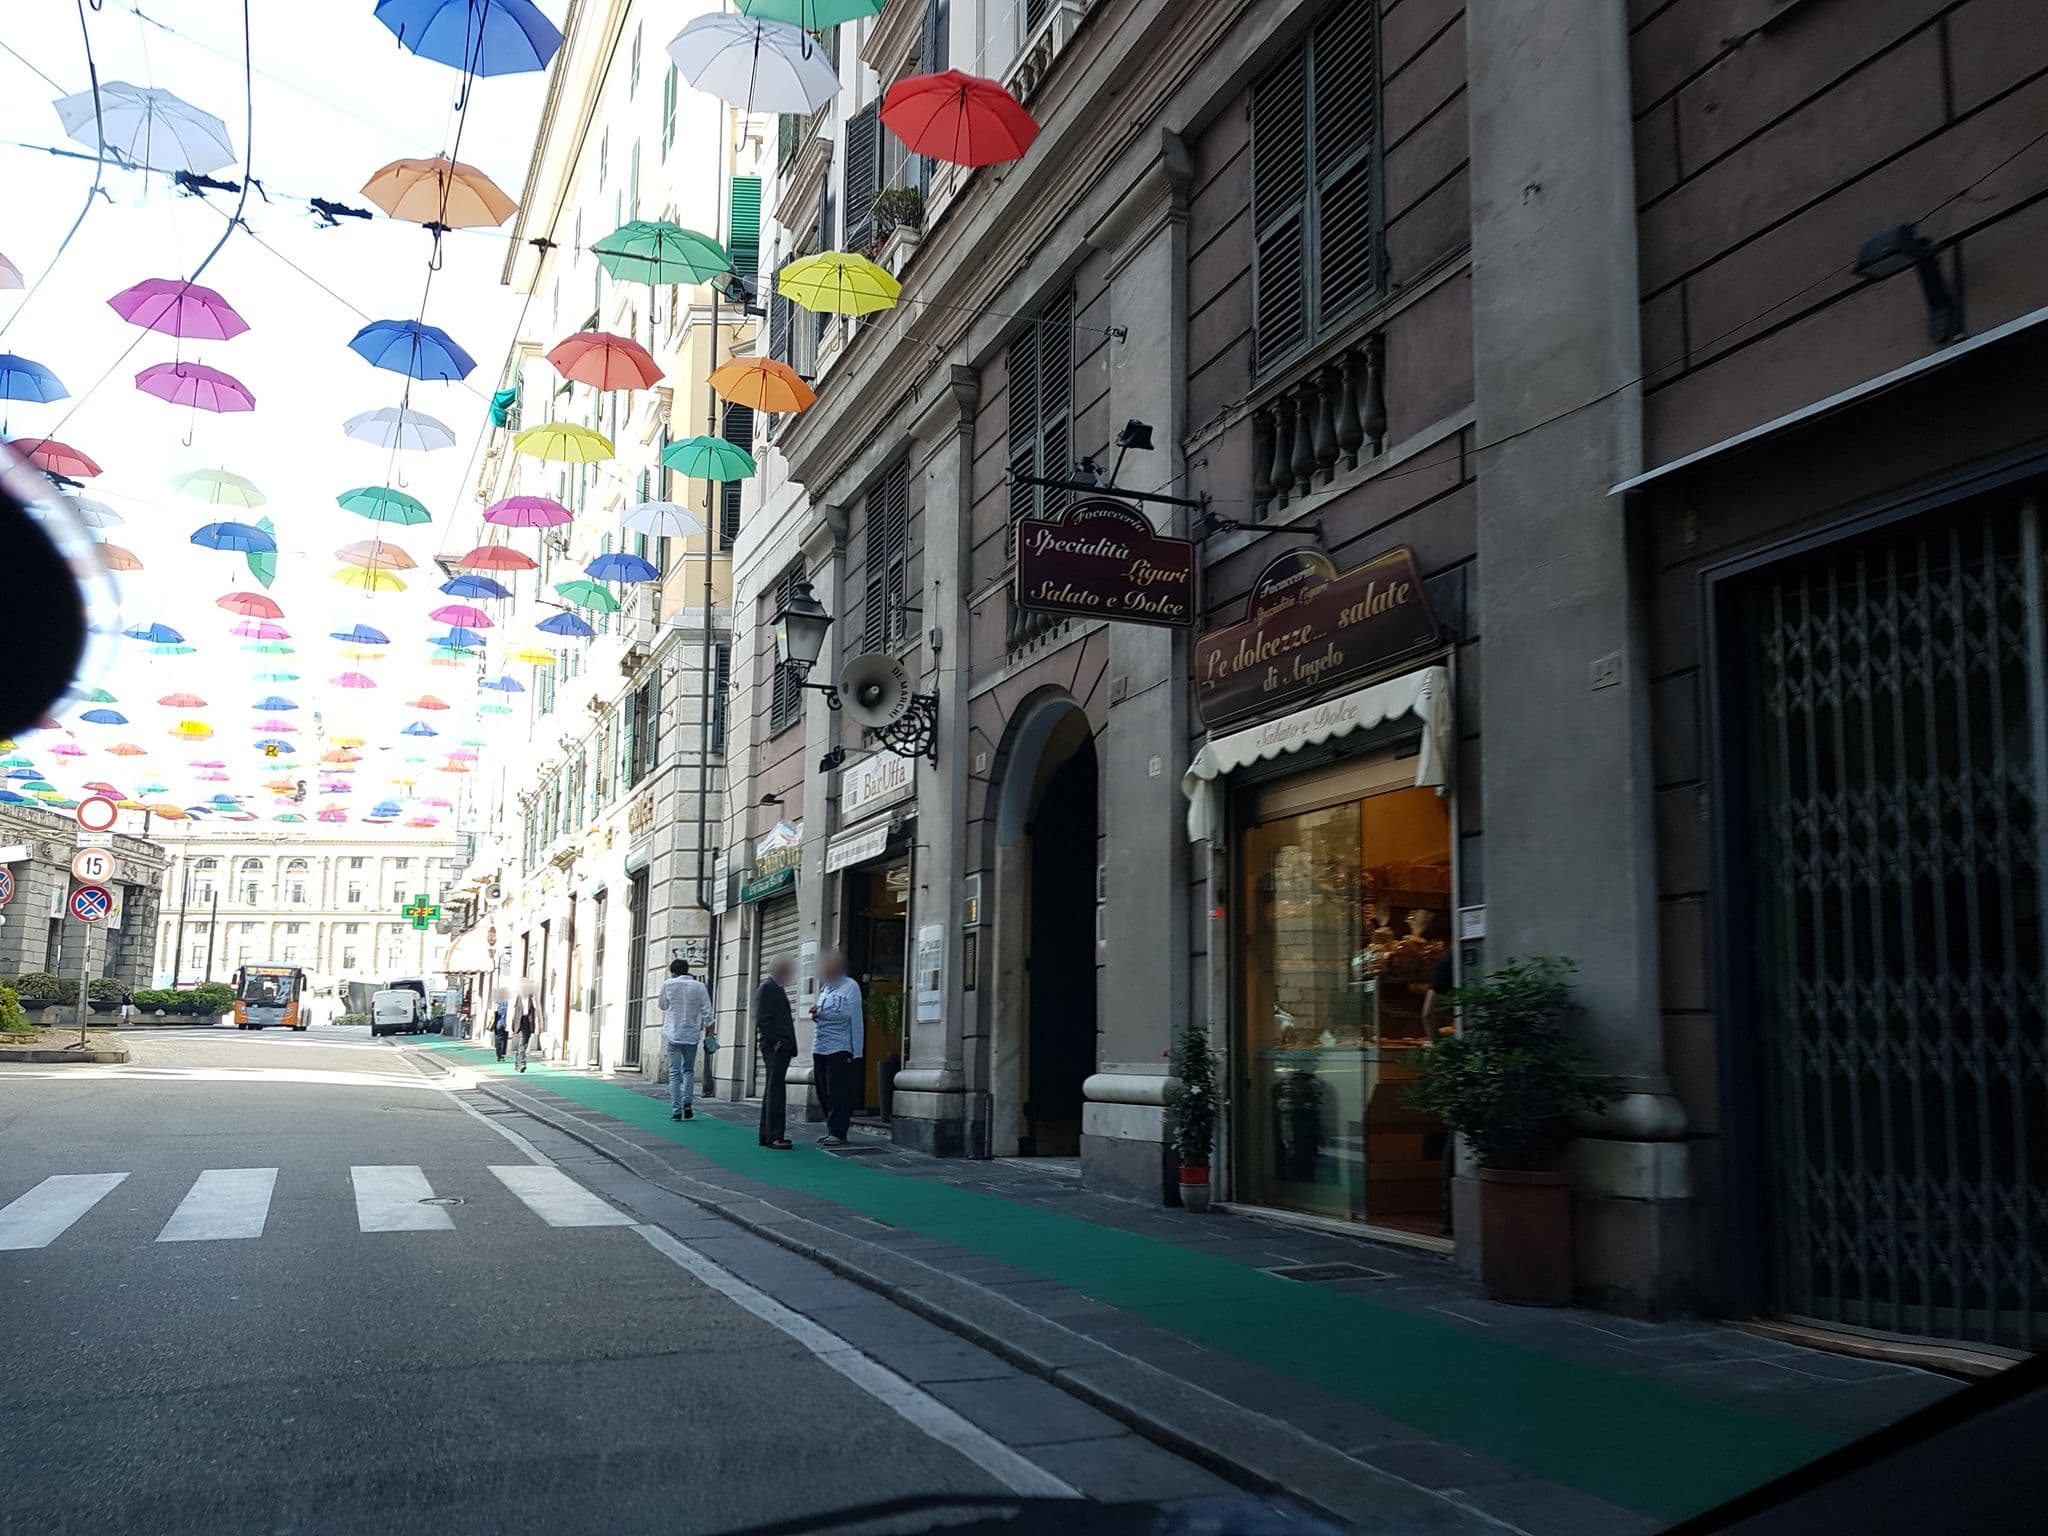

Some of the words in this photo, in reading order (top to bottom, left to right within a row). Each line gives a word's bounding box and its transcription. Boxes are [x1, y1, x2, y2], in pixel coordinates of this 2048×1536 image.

[1025, 528, 1130, 560] Specialità
[1120, 558, 1190, 587] Liguri
[1030, 580, 1100, 606] Salato
[1106, 596, 1118, 608] e
[1123, 590, 1185, 616] Dolce
[1201, 649, 1228, 690] Le
[1337, 581, 1410, 629] salate
[1263, 665, 1279, 692] di
[1282, 641, 1344, 686] Angelo
[86, 857, 104, 875] 15
